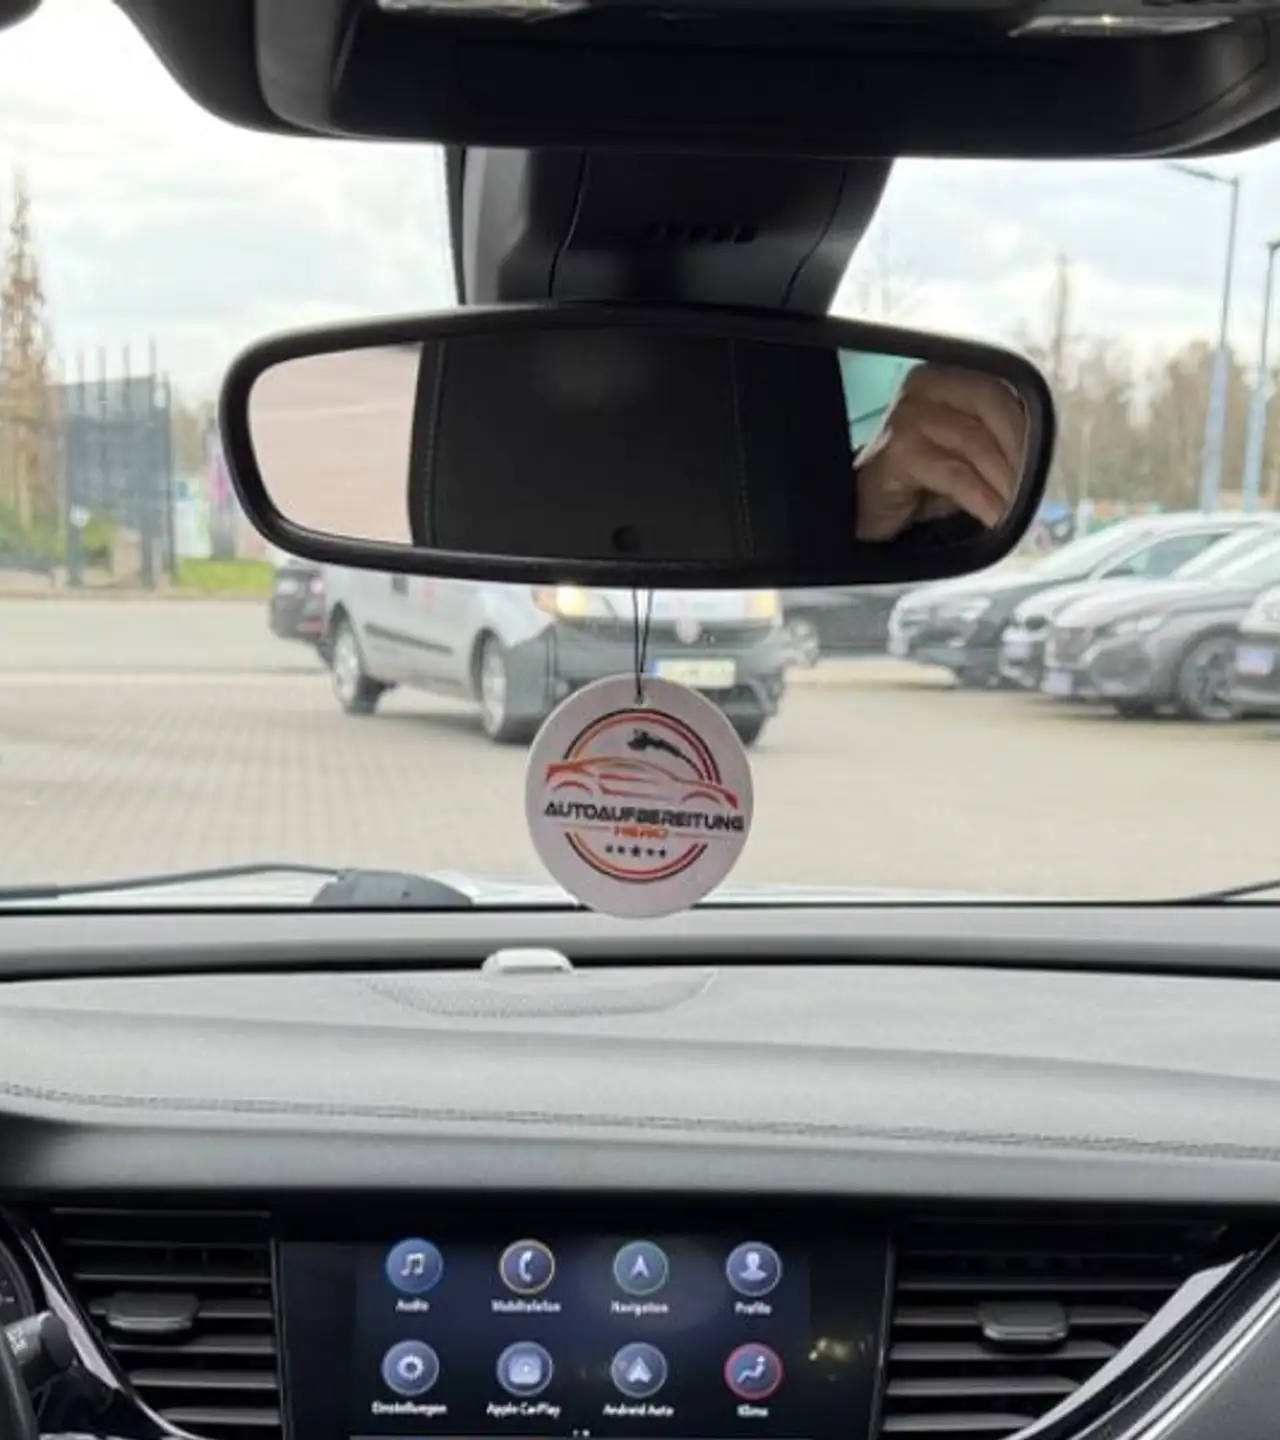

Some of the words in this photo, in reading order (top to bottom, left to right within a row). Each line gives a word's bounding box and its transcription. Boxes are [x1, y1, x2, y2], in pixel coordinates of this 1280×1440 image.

[544, 801, 744, 832] AUTOAUFBEREITUNG
[395, 1300, 430, 1312] Audio
[491, 1300, 562, 1313] Mobiltelefon
[611, 1301, 669, 1317] Navigation
[735, 1302, 772, 1315] Profile
[371, 1401, 447, 1416] Einstellungen
[486, 1402, 517, 1417] Apple
[521, 1402, 561, 1418] CarPlay
[603, 1404, 646, 1416] Android
[648, 1404, 675, 1417] Auto
